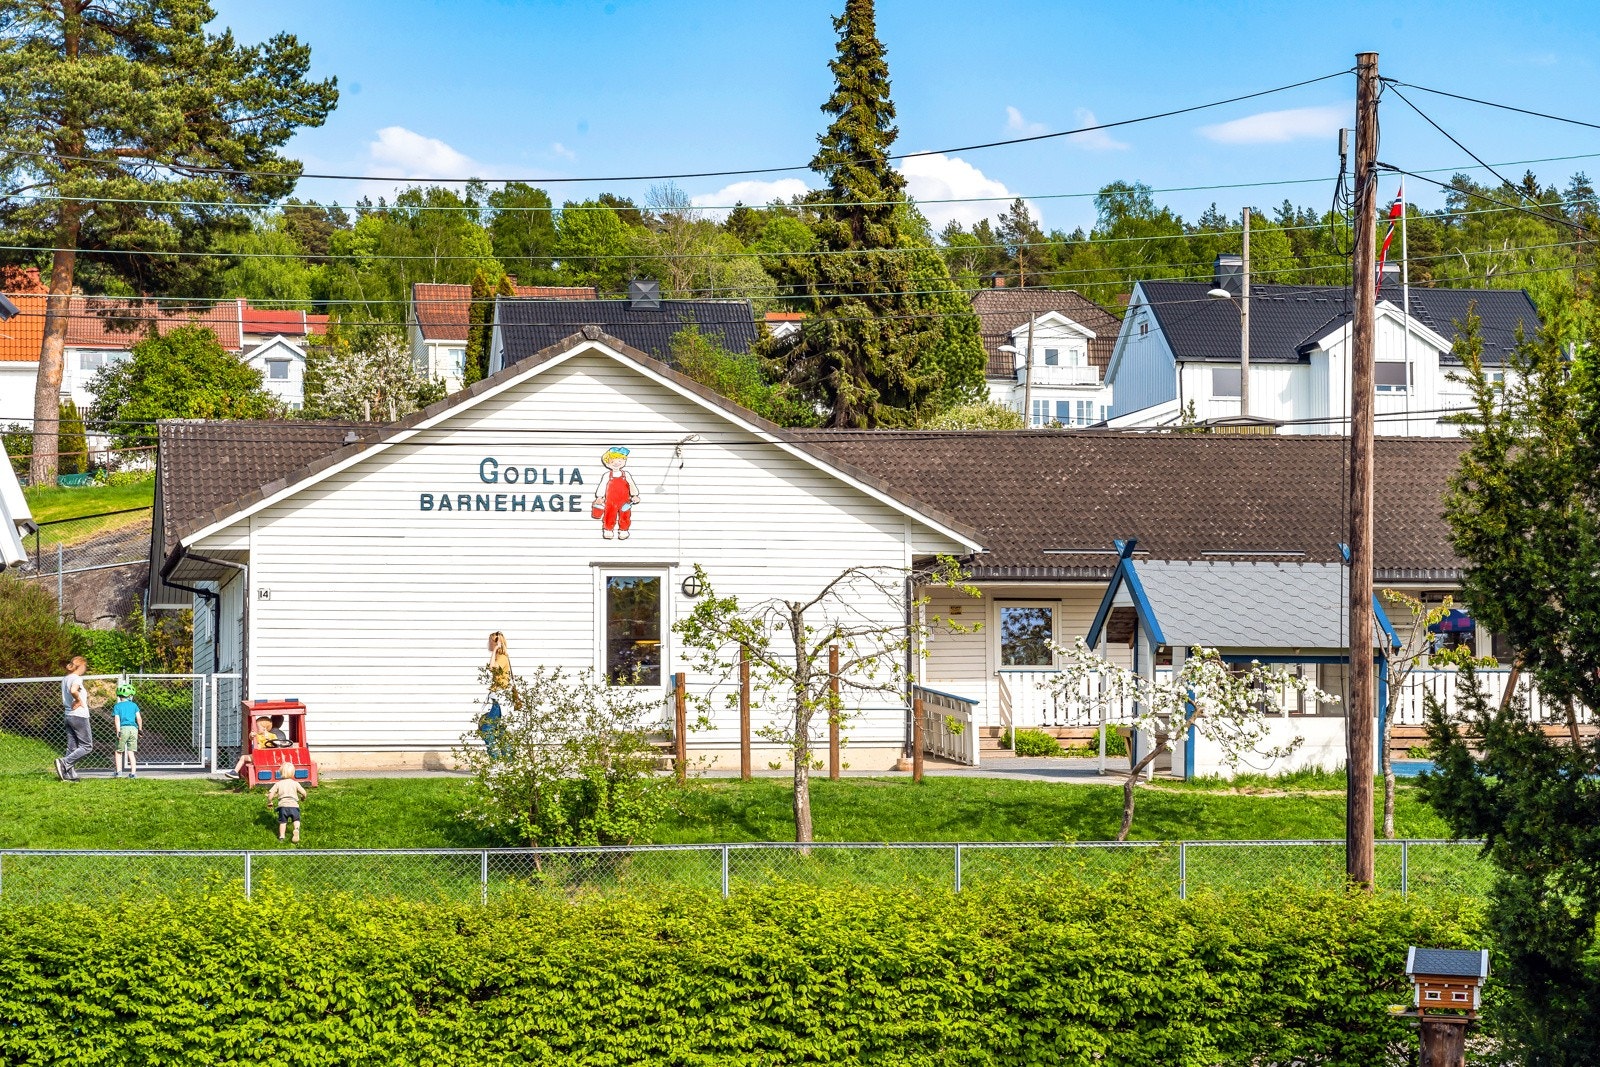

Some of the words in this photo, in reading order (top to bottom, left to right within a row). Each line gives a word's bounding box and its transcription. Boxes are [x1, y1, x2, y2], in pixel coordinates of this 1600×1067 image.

[479, 457, 584, 485] GODLIA
[419, 493, 583, 513] BARNEHAGE
[259, 590, 269, 599] 14
